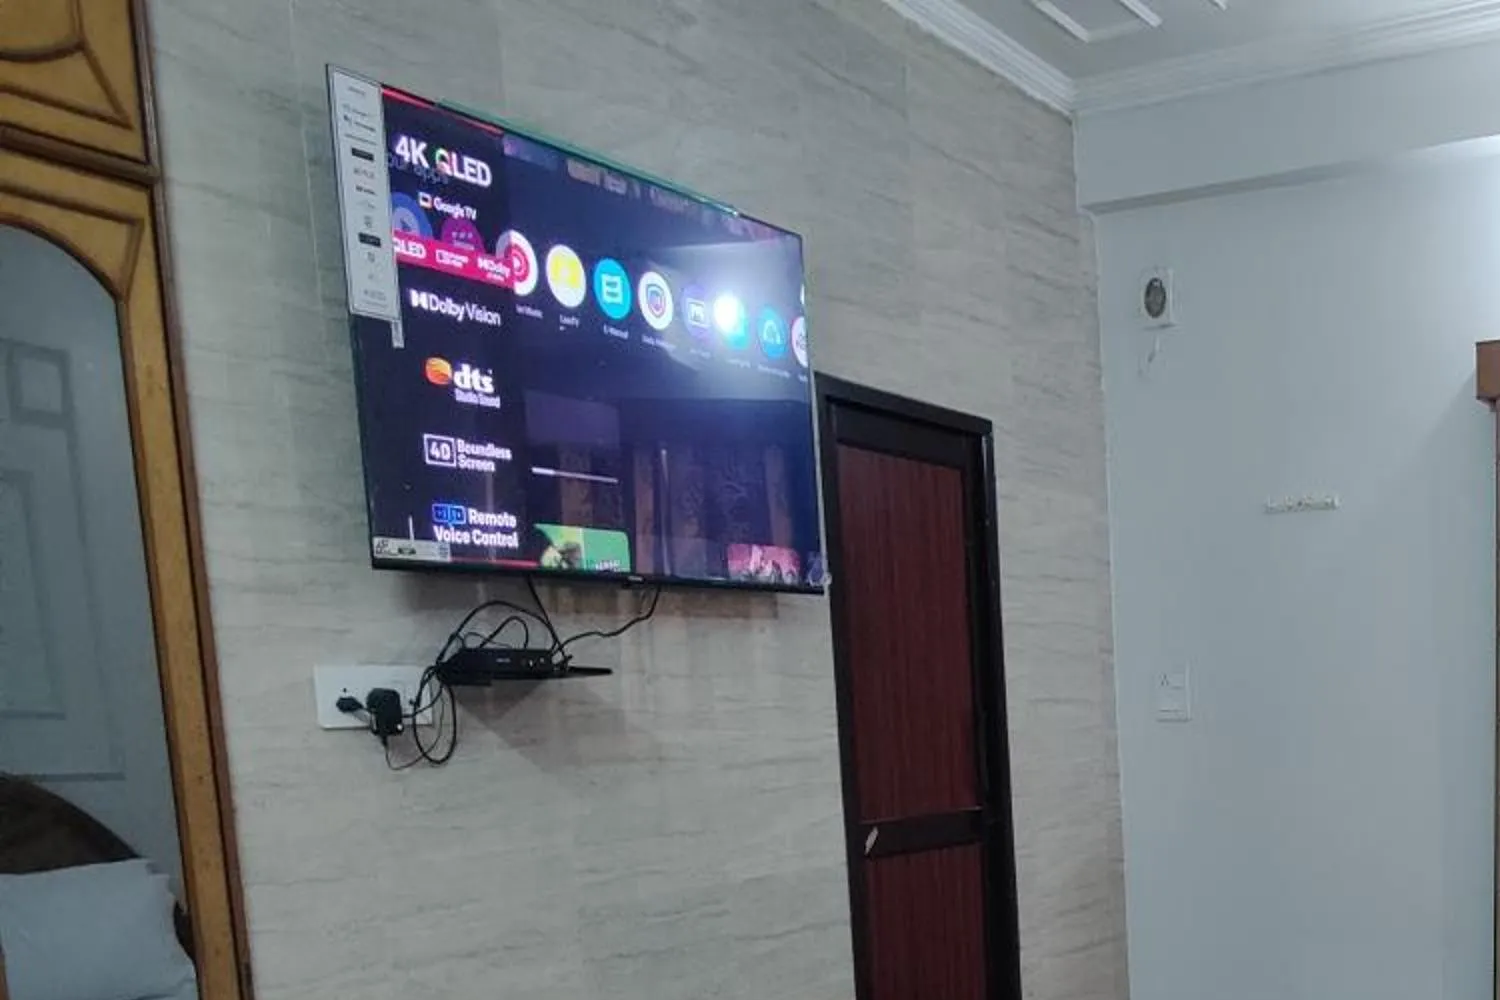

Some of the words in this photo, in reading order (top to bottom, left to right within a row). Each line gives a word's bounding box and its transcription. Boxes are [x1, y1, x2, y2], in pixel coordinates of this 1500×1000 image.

[395, 135, 429, 169] 4K
[435, 148, 493, 187] QLED
[428, 293, 465, 323] Dolby
[464, 302, 502, 327] Vision
[453, 362, 495, 394] dts
[457, 438, 513, 461] Boundless
[458, 453, 496, 472] Screen
[467, 507, 517, 529] Remote
[432, 525, 471, 545] Voice
[471, 529, 519, 549] Control
